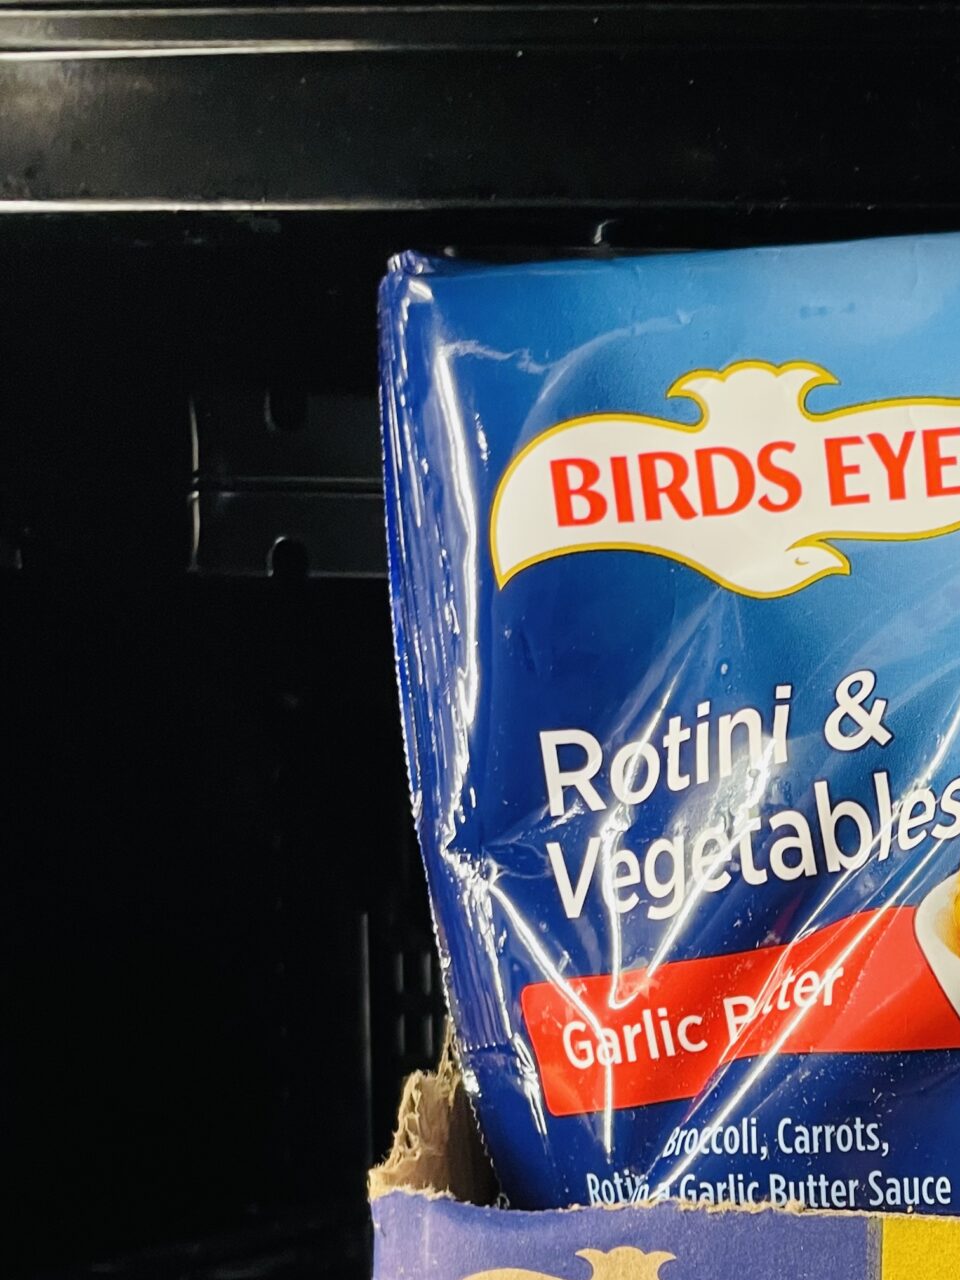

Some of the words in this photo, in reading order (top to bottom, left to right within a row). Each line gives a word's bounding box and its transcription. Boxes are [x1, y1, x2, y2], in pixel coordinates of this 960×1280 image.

[549, 440, 803, 527] BIRDS
[539, 684, 791, 818] Rotini
[823, 669, 893, 752] &
[561, 1008, 708, 1070] Garlic
[662, 1117, 768, 1160] Broccoli,
[777, 1116, 890, 1157] Carrots,
[679, 1173, 759, 1205] Garlic
[770, 1172, 859, 1208] Butter
[868, 1170, 952, 1206] Sauce
